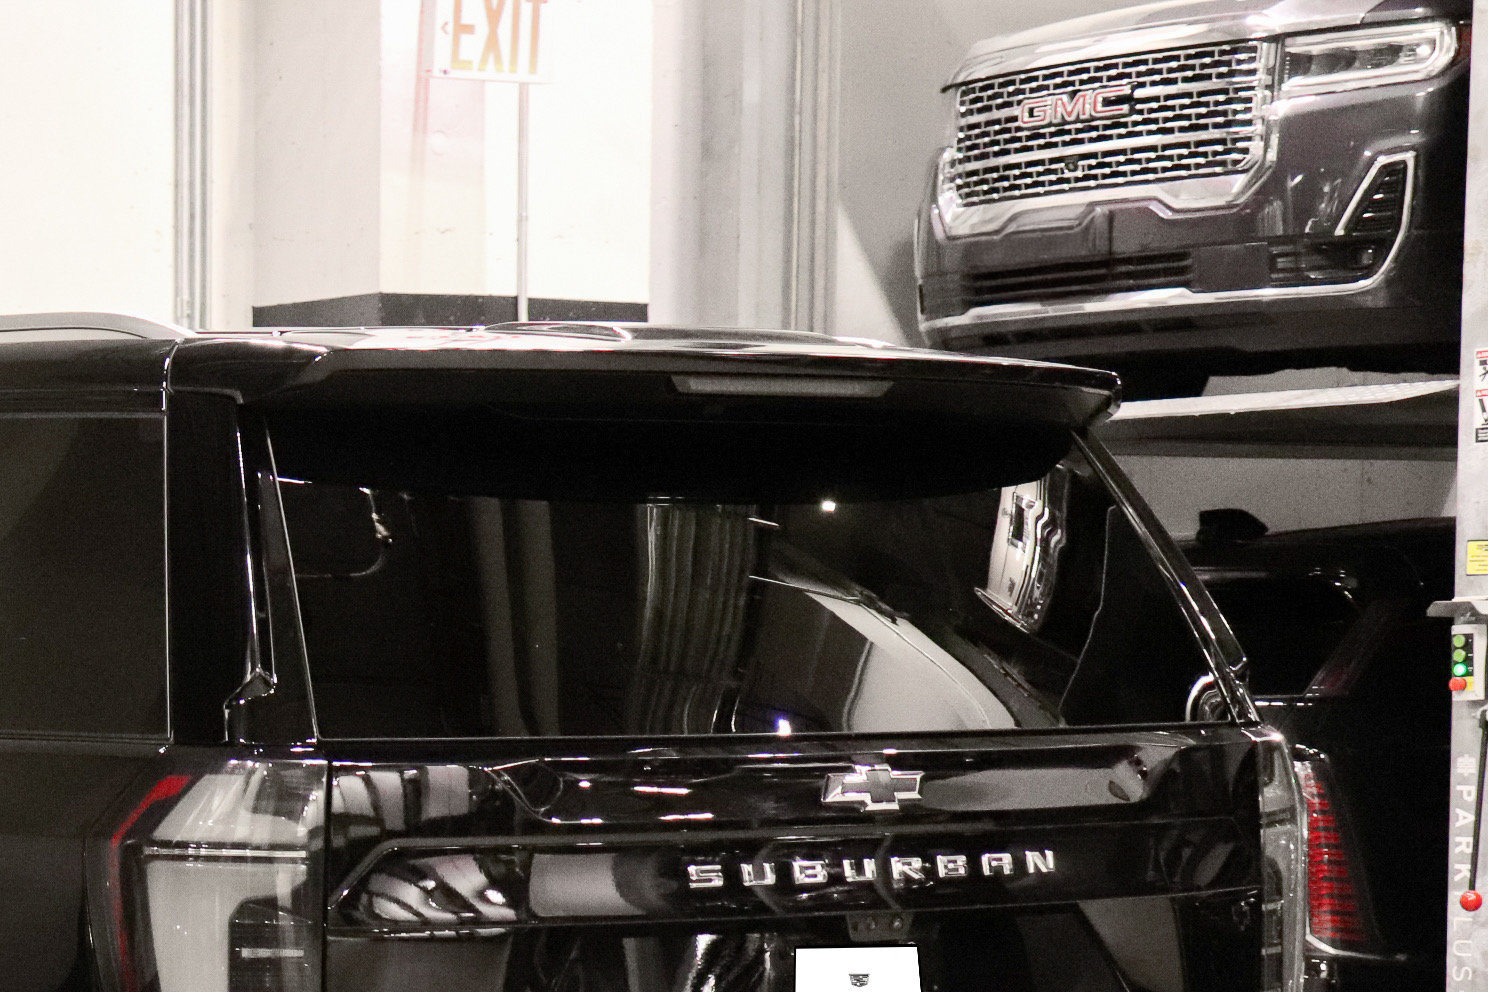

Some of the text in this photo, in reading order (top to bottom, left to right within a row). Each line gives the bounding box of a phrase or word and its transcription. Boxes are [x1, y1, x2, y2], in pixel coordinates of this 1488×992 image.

[451, 0, 548, 75] EXIT
[1019, 85, 1132, 127] GMC
[687, 850, 1055, 889] SUBURBAN
[1452, 785, 1476, 981] PARKLUS
